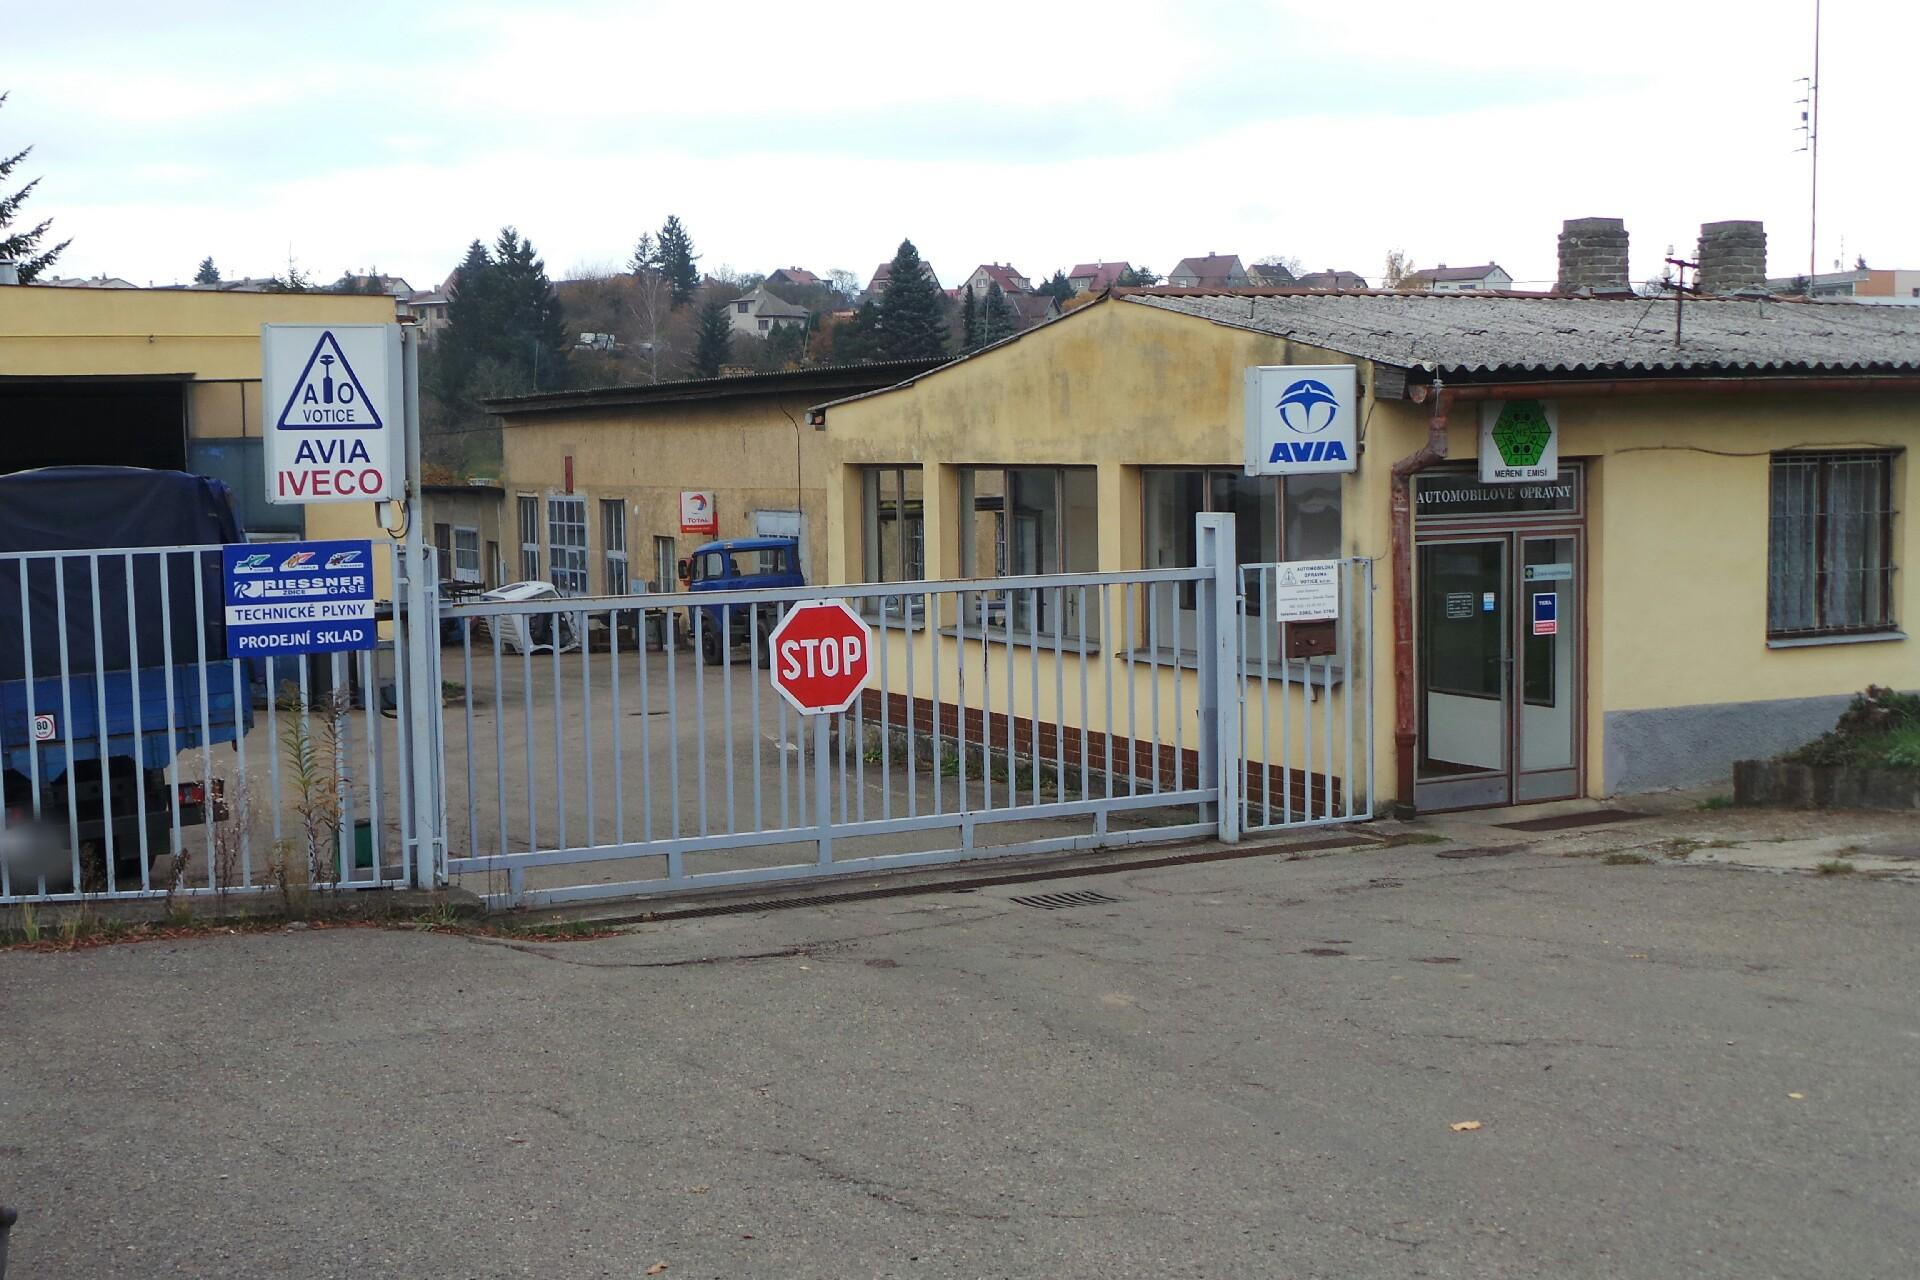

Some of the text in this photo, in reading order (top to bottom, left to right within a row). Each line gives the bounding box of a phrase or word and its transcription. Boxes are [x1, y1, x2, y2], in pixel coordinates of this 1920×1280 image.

[303, 409, 355, 423] VOTICE
[295, 438, 371, 465] AVIA
[1269, 440, 1347, 463] AVIA
[278, 468, 383, 497] IVECO
[264, 576, 365, 590] RIESSNER
[328, 585, 366, 595] GASE
[235, 603, 366, 621] TECHNICKÉ PLYNY
[239, 629, 364, 649] PRODEJNÍ SKLAD
[781, 635, 862, 680] STOP
